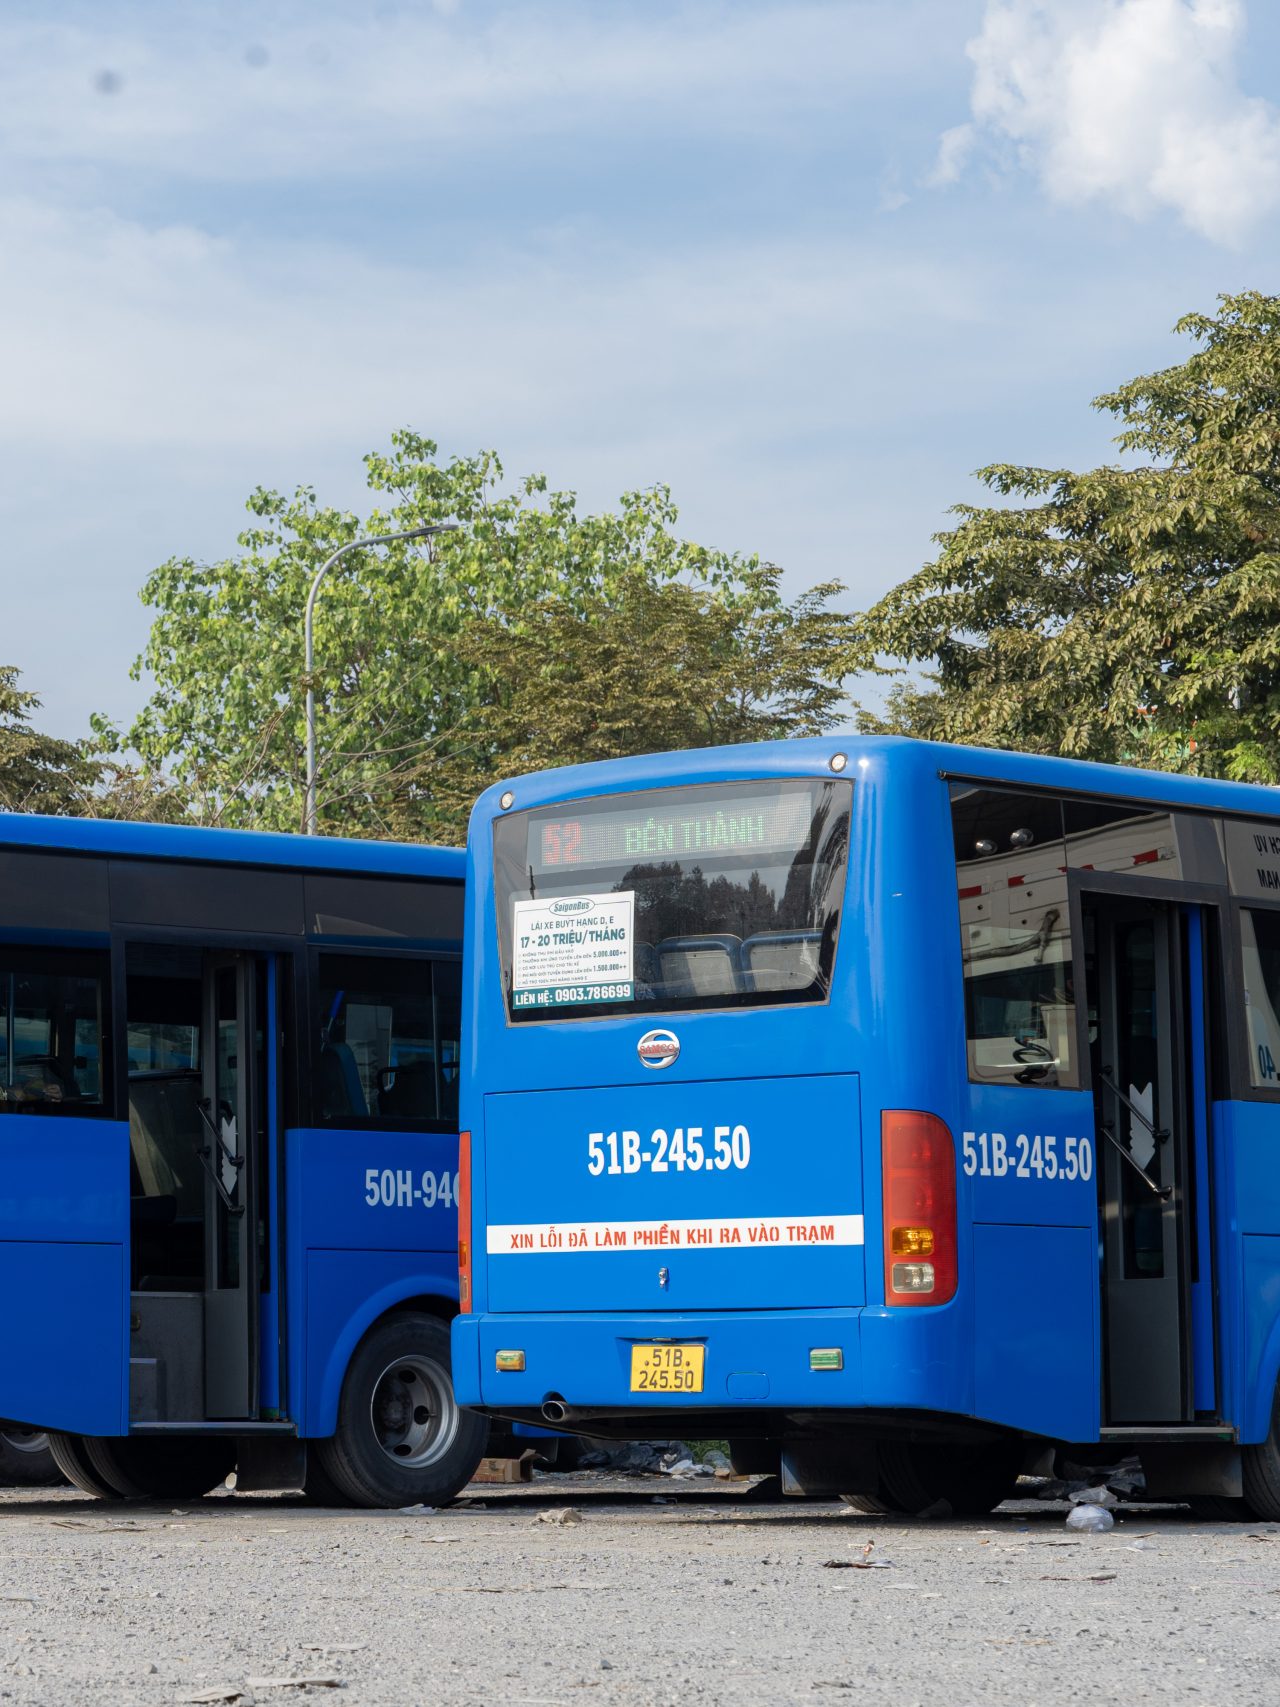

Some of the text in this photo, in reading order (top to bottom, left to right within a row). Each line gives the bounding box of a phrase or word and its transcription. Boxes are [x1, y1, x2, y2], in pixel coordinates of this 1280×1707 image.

[544, 822, 583, 865] 52
[554, 901, 590, 913] SaigonBus
[531, 916, 615, 931] LÁI XE BUÝT HẠNG D, E
[520, 936, 530, 948] 17
[538, 935, 550, 947] 20
[515, 984, 631, 1006] LIÊN HỆ: 0903.786699
[588, 1124, 751, 1176] 51B-245.50
[962, 1132, 1093, 1182] 51B-245.50
[510, 1224, 835, 1249] XIN LỖI ĐÃ LÀM PHIỀN KHI RA VÀO TRẠM
[652, 1349, 683, 1367] 51B
[638, 1370, 694, 1389] 245.50
